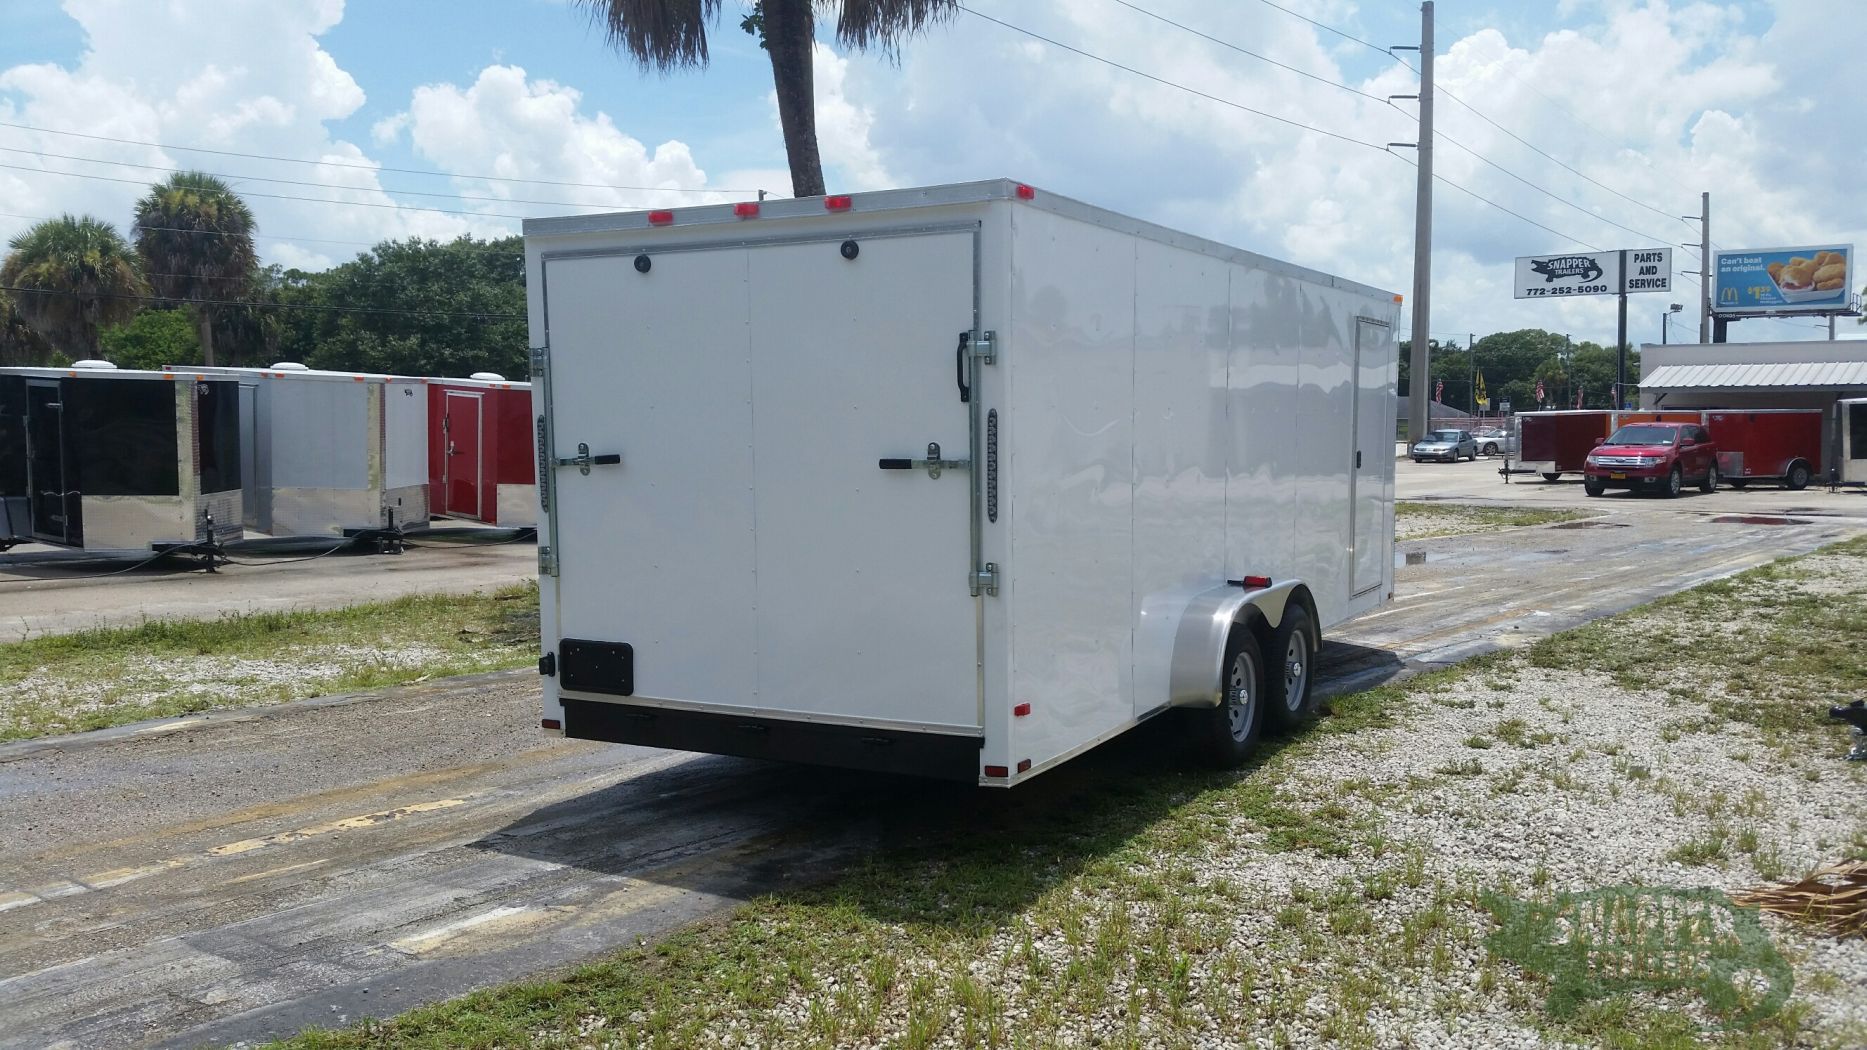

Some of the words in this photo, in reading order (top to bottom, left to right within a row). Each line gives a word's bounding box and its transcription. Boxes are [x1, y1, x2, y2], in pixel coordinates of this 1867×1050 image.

[1634, 252, 1663, 263] PARTS
[1721, 257, 1743, 265] Can't
[1547, 258, 1591, 270] SNAPPER
[1554, 267, 1585, 276] TRAILERS
[1639, 265, 1657, 276] AND
[1628, 278, 1667, 289] SERVICE
[1526, 285, 1608, 296] 772-252-5090
